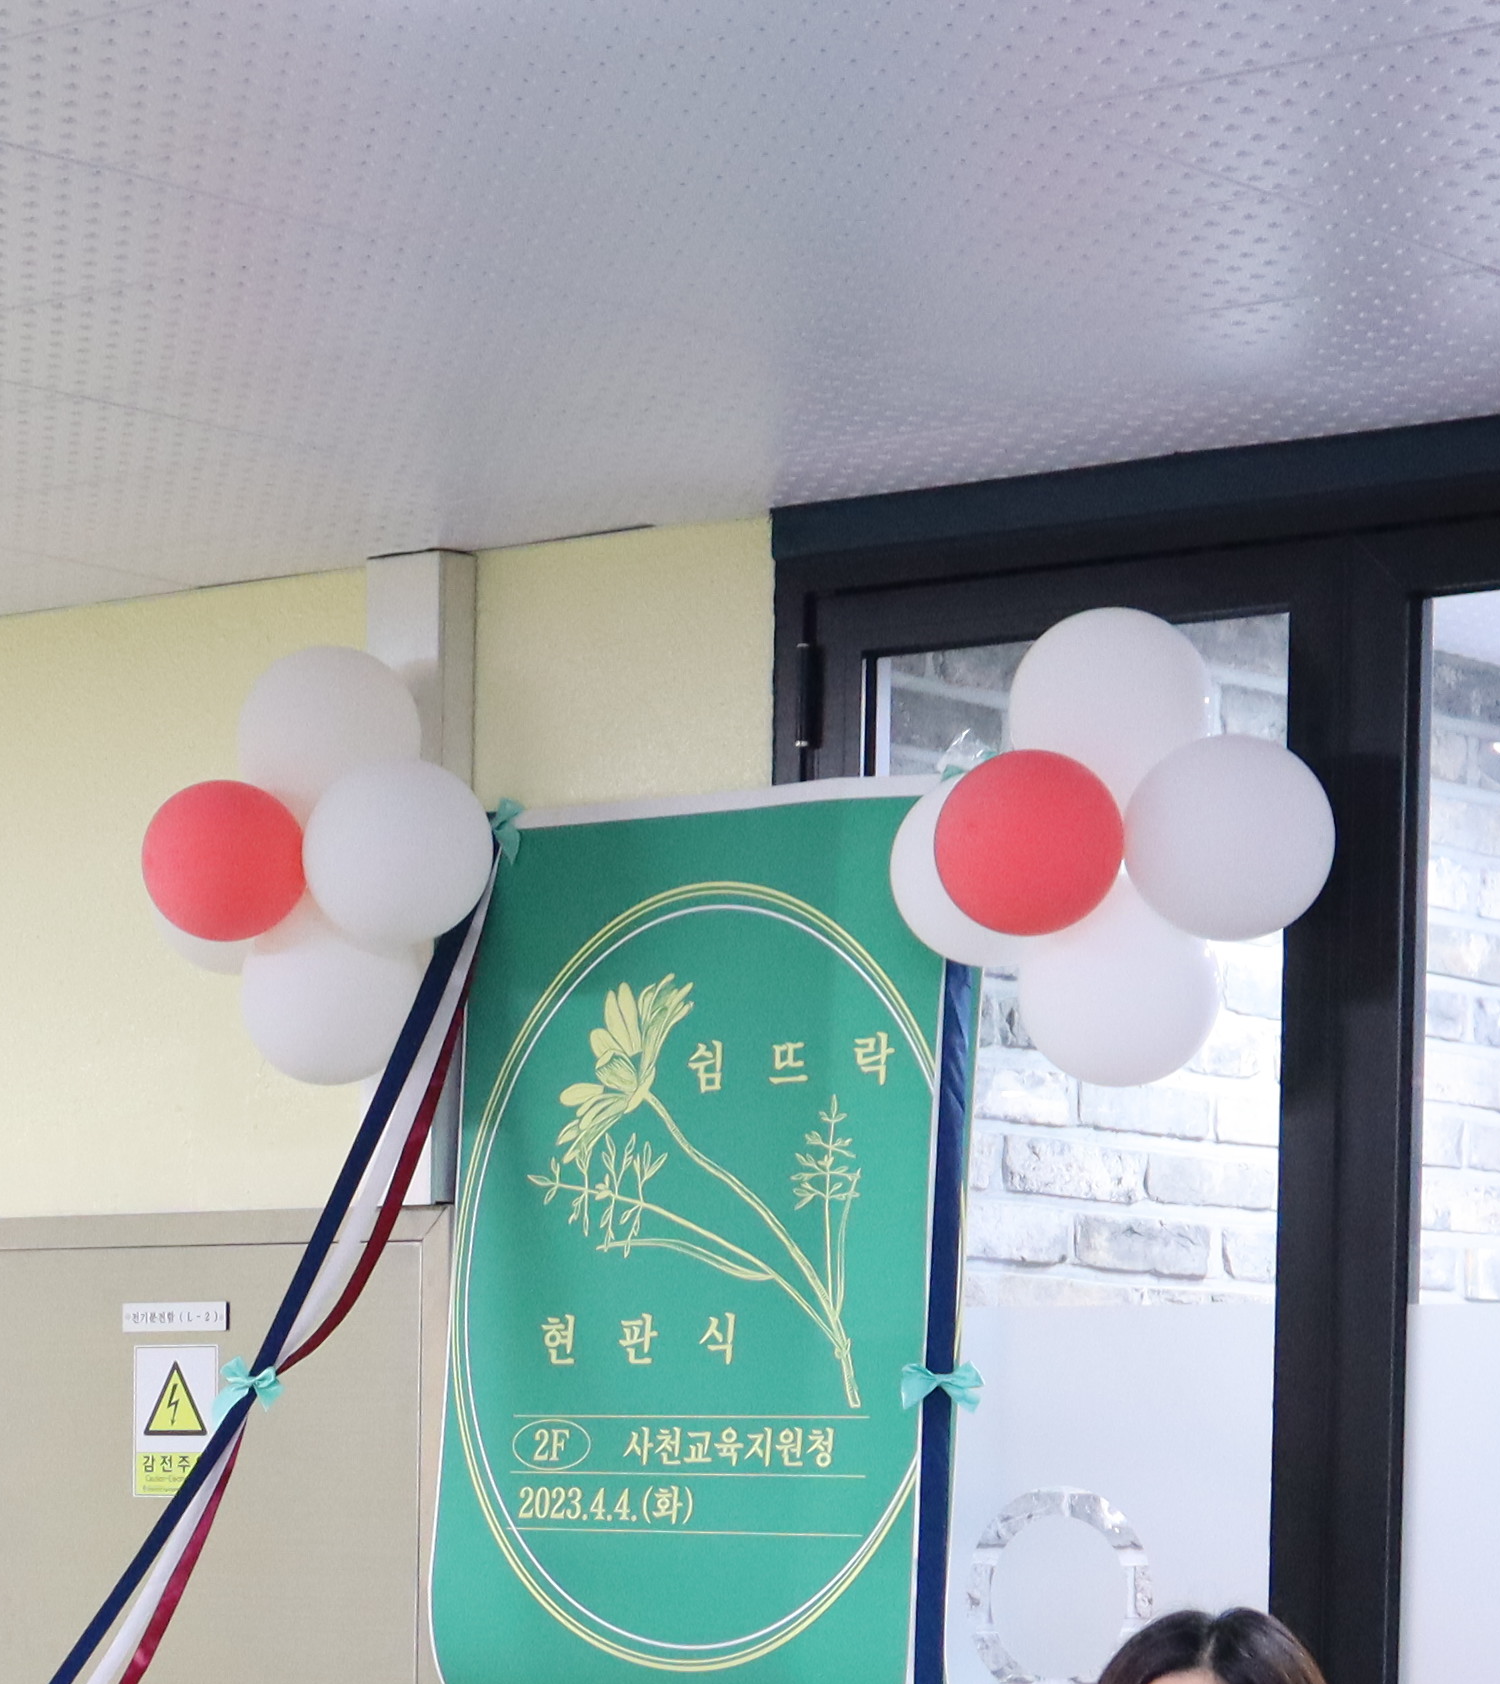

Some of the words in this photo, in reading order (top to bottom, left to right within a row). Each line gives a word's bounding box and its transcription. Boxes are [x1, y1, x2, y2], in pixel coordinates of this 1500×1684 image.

[541, 1312, 737, 1366] 현판식
[143, 1454, 200, 1473] 감전주
[533, 1429, 570, 1462] 2F
[623, 1429, 834, 1468] 사천교육지원청
[518, 1484, 694, 1524] 2023.4.4.(화)
